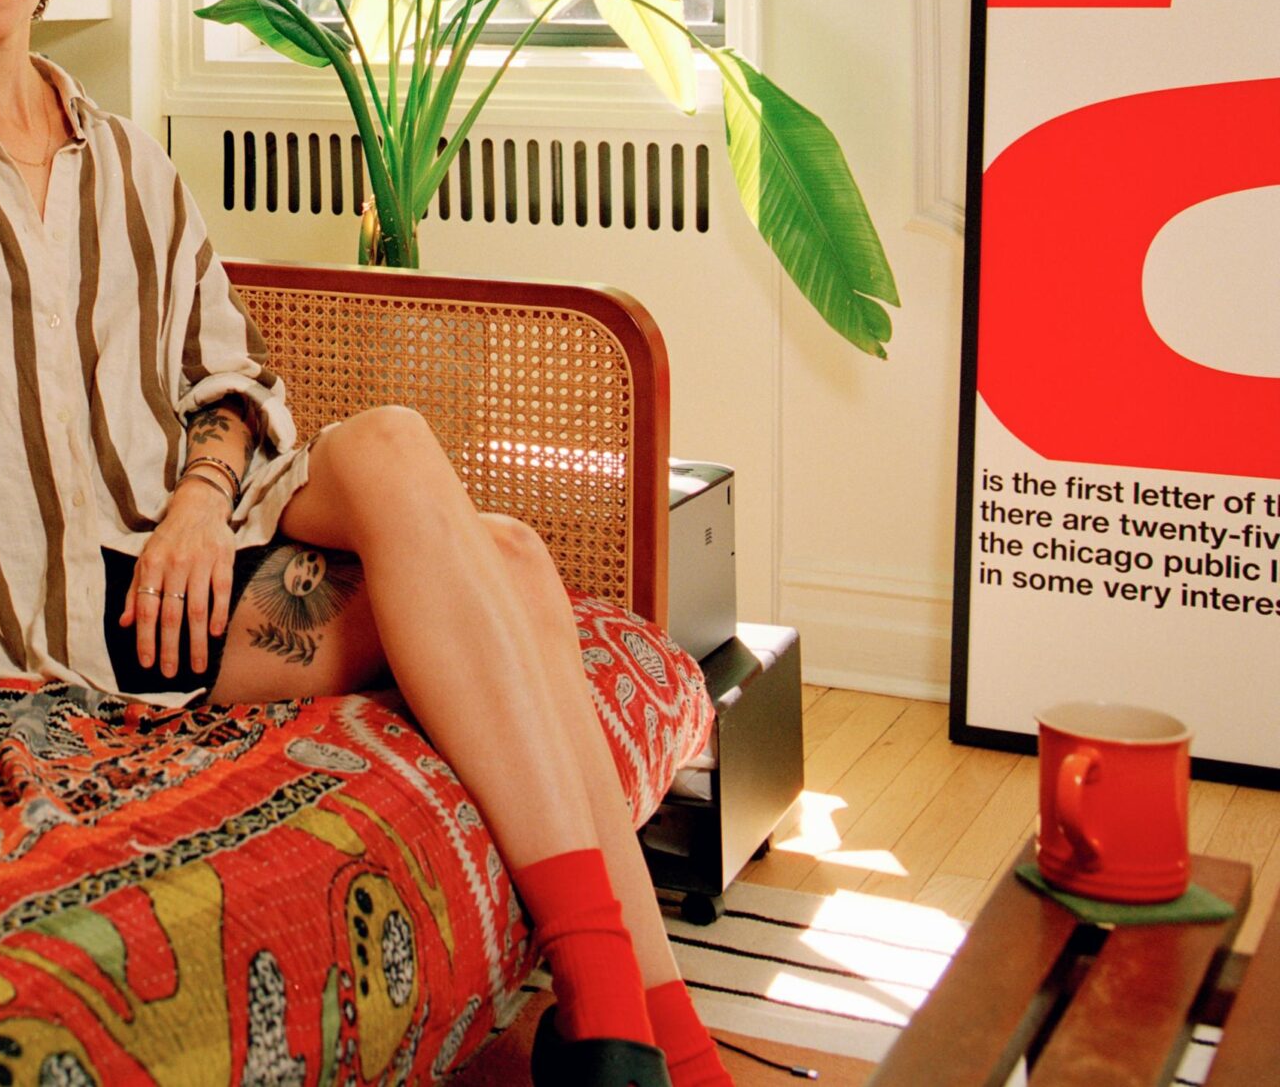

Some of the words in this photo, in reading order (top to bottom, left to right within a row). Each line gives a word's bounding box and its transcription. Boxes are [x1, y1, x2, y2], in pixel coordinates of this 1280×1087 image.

[982, 469, 1003, 491] is
[1012, 472, 1057, 496] the
[1066, 476, 1124, 503] first
[1133, 482, 1215, 511] letter
[1224, 491, 1256, 515] of
[980, 500, 1052, 528] there
[1062, 513, 1109, 533] are
[1119, 514, 1280, 550] twenty-fiv
[979, 531, 1023, 556] the
[1033, 537, 1153, 573] chicago
[1164, 552, 1261, 582] public
[980, 562, 1001, 586] in
[1012, 570, 1094, 596] some
[1104, 580, 1171, 609] very
